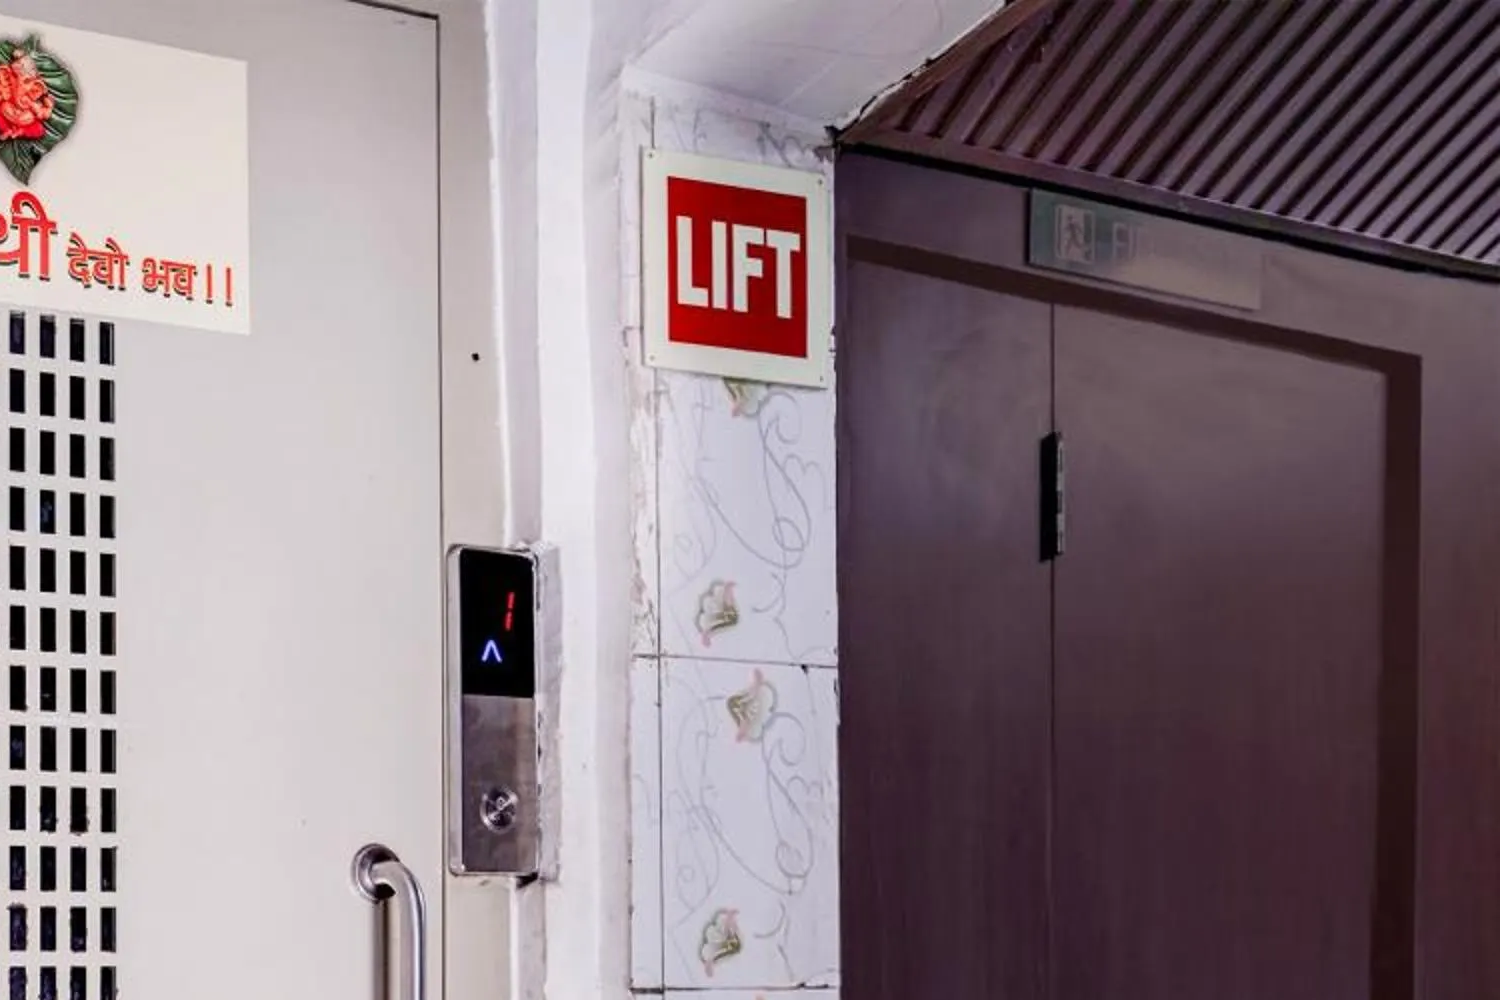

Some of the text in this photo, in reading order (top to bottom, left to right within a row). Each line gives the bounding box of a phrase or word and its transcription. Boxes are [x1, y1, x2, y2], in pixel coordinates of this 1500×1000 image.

[67, 231, 129, 289] देवो
[676, 214, 801, 320] LIFT
[504, 591, 516, 632] 1
